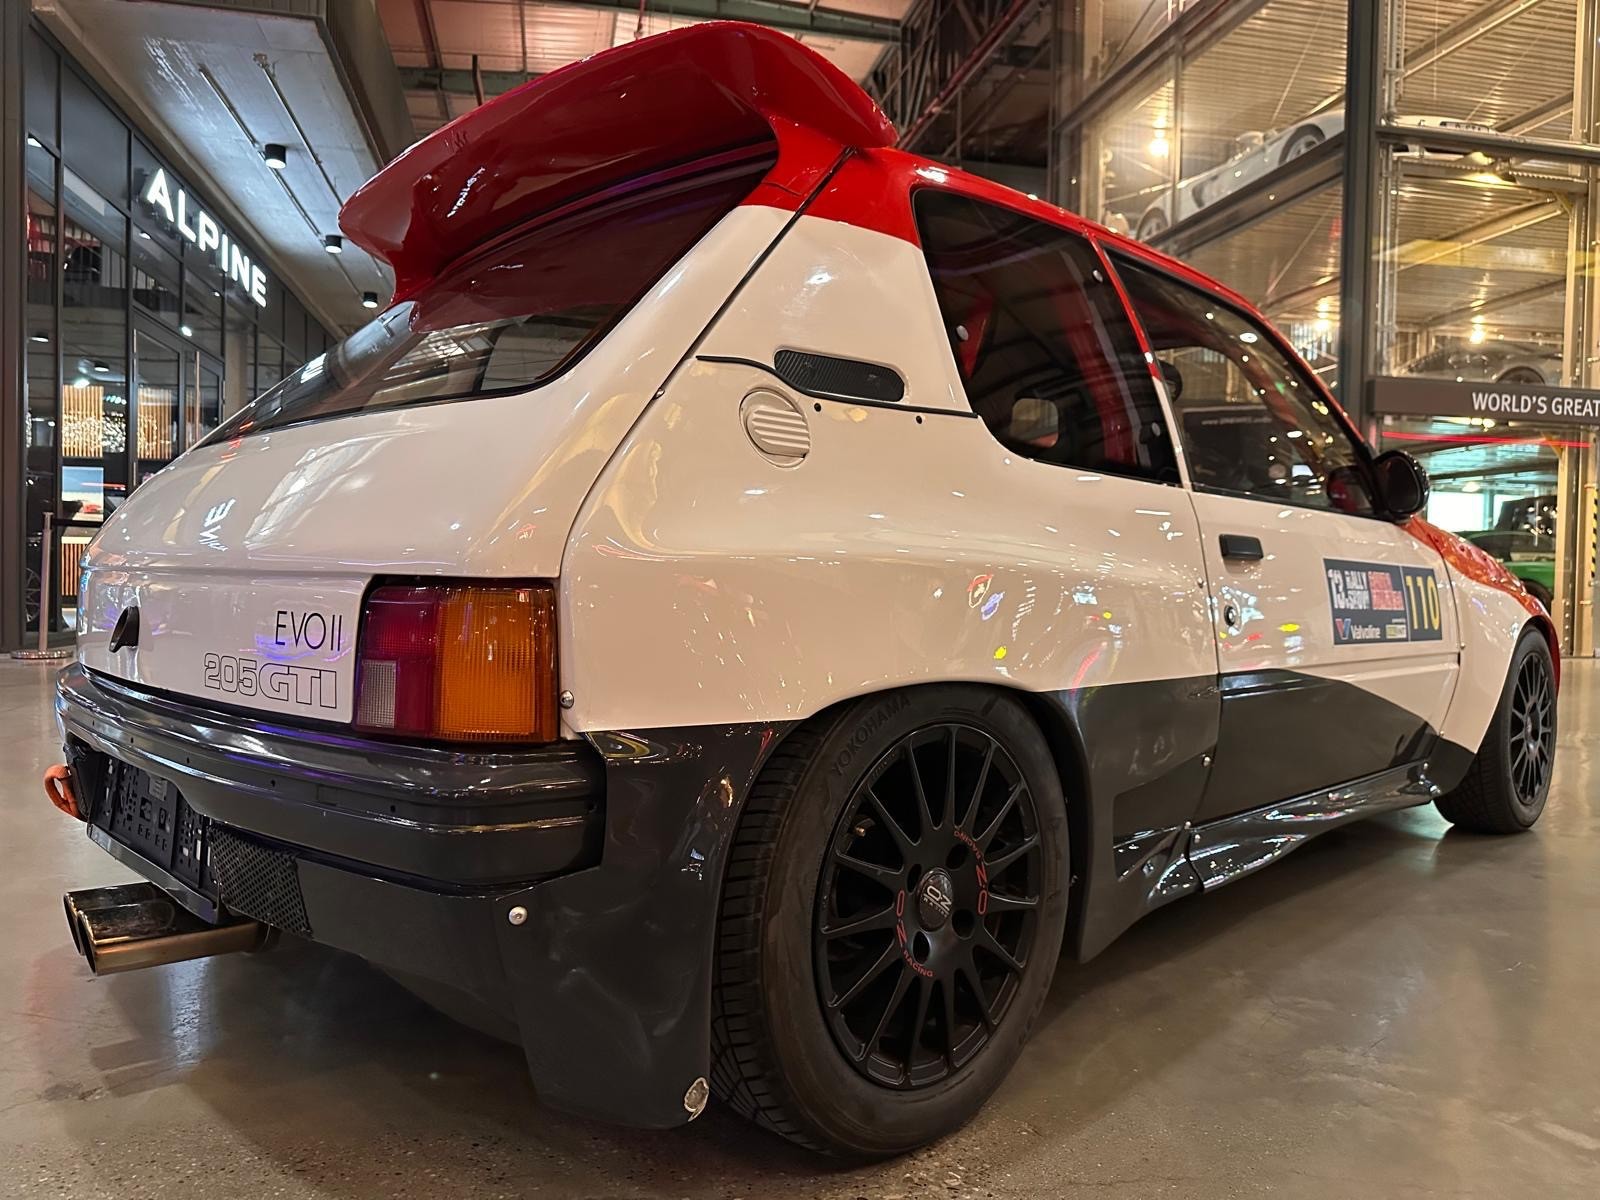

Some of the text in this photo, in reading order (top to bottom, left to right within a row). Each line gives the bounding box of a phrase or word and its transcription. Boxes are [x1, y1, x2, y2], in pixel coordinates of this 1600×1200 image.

[146, 169, 266, 307] ALPINE
[1472, 392, 1600, 416] WORLD'S GREAT
[1406, 576, 1440, 630] 110
[832, 695, 911, 775] YOKOHAMA
[902, 950, 933, 978] RACING
